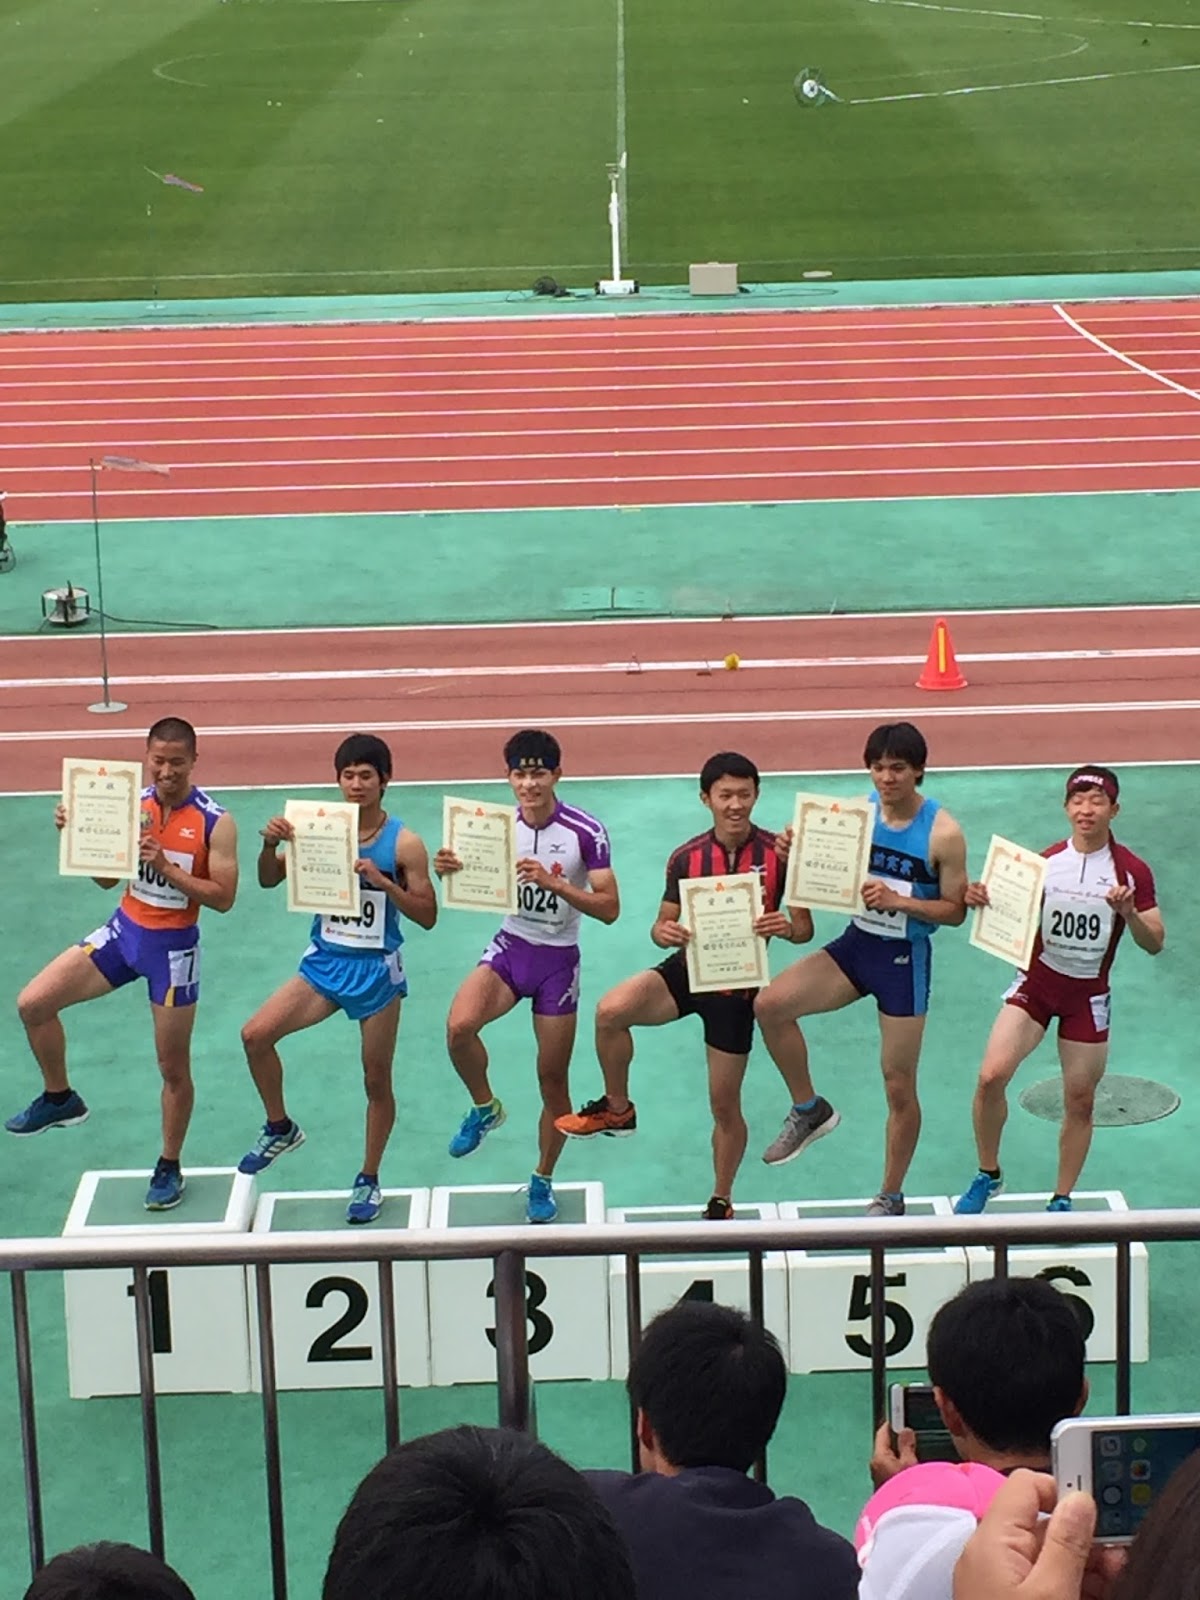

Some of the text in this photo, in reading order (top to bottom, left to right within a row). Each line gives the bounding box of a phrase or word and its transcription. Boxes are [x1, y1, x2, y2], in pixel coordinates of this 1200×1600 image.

[183, 950, 195, 982] 7
[1051, 910, 1100, 940] 2089
[127, 1270, 172, 1353] 1
[306, 1275, 373, 1362] 2
[485, 1270, 554, 1356] 3
[845, 1272, 914, 1357] 5
